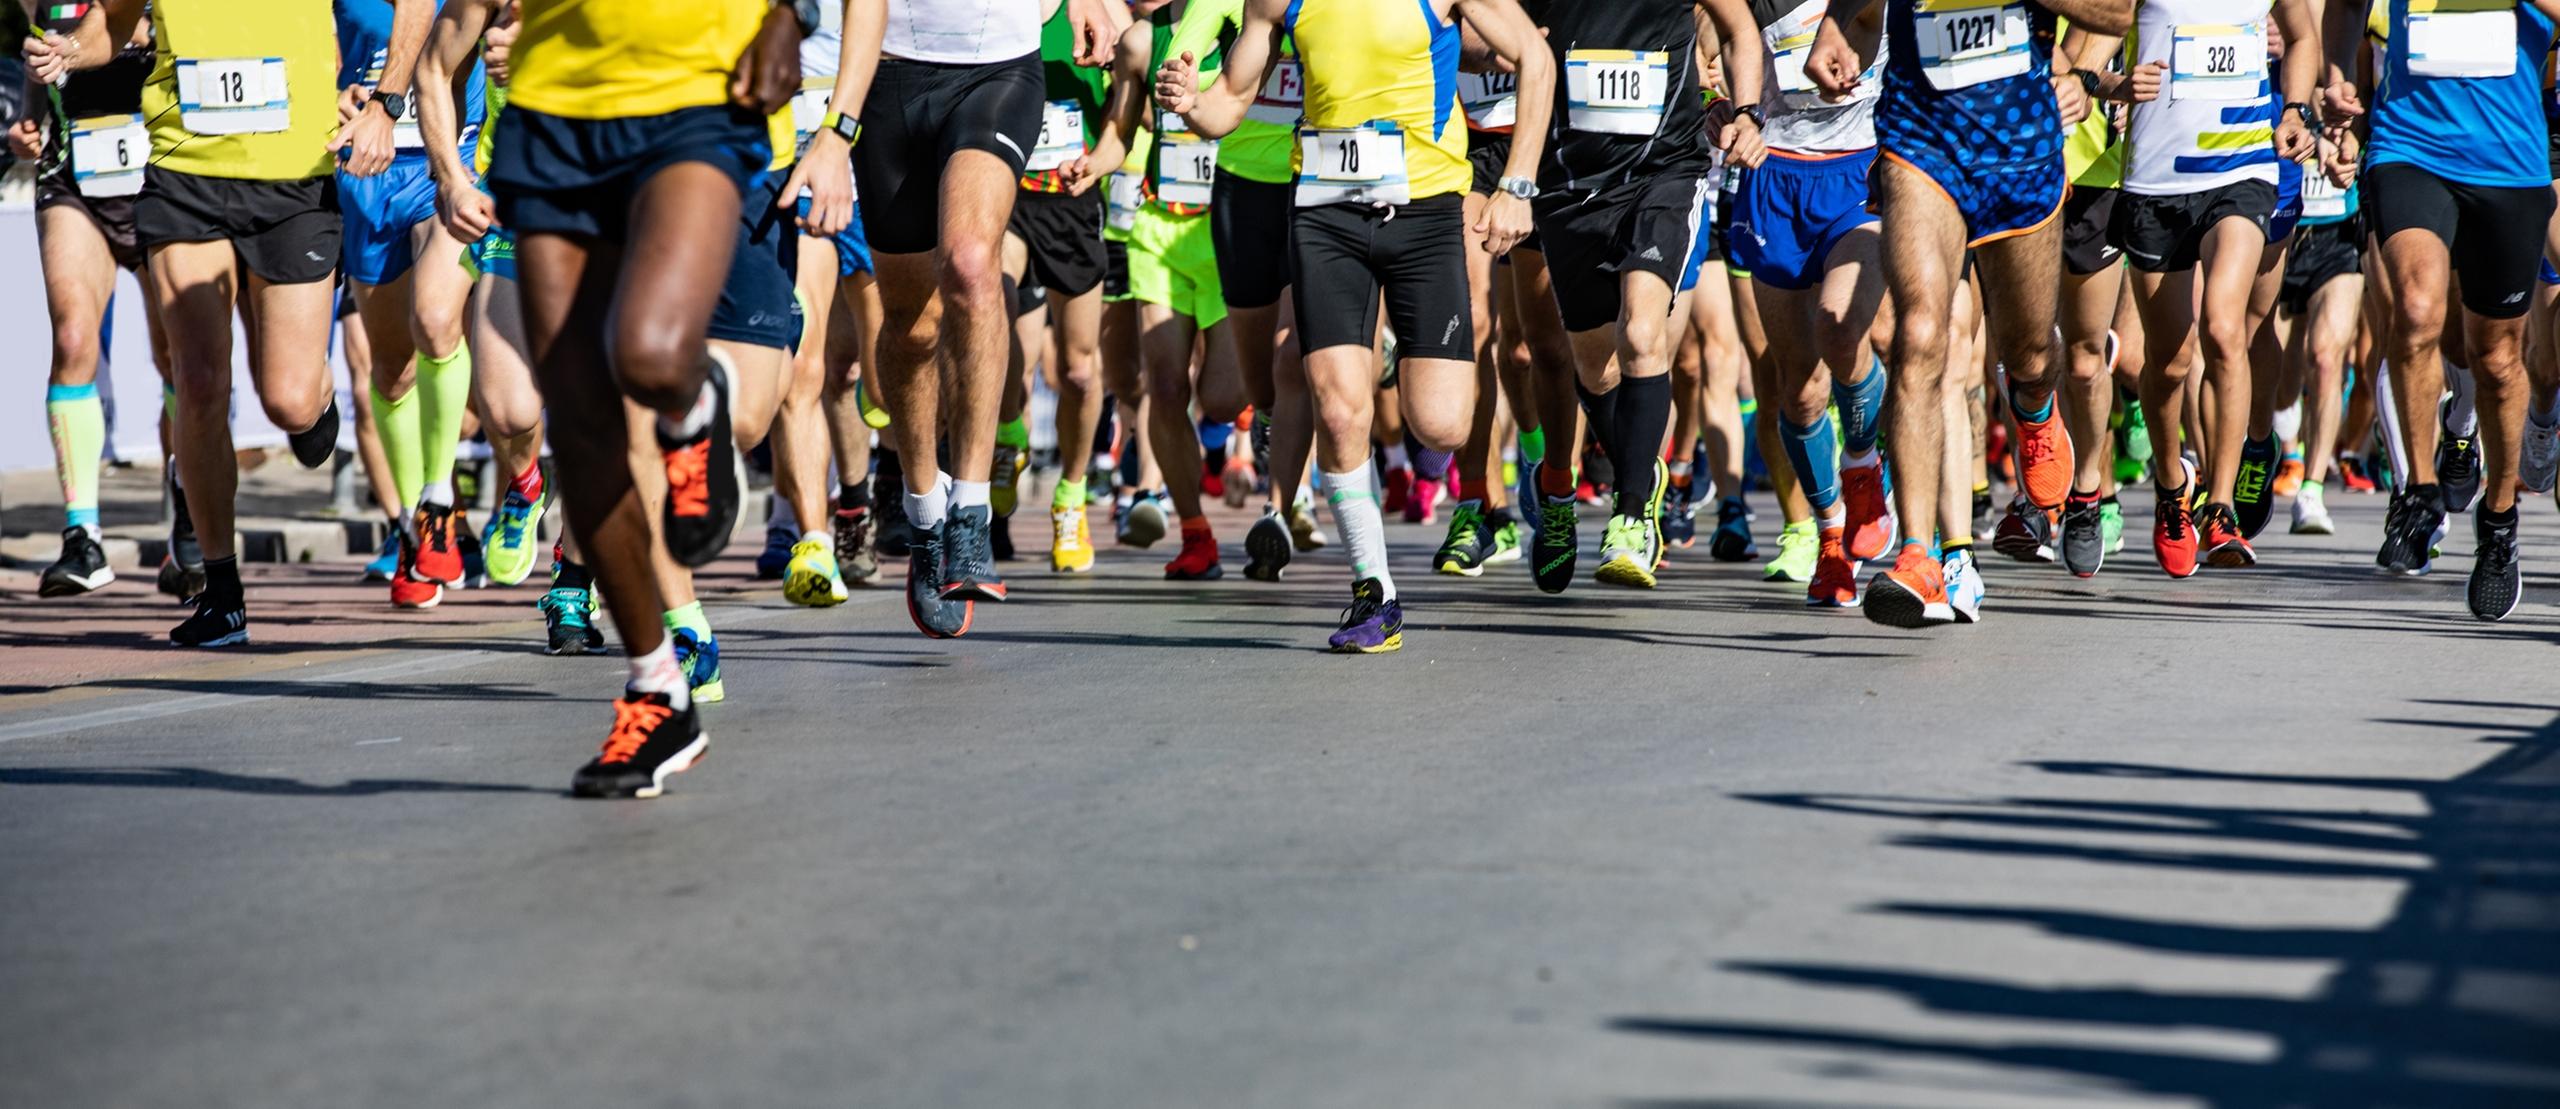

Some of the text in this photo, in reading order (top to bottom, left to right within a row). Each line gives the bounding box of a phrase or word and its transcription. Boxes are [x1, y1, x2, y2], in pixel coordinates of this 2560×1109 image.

[1946, 15, 1994, 52] 1227
[2207, 46, 2235, 73] 328
[220, 72, 243, 103] 18
[1279, 67, 1303, 97] F-
[1480, 71, 1516, 96] 122
[1597, 69, 1640, 100] 1118
[117, 139, 128, 166] 6
[1338, 139, 1359, 173] 10
[1194, 156, 1211, 180] 16
